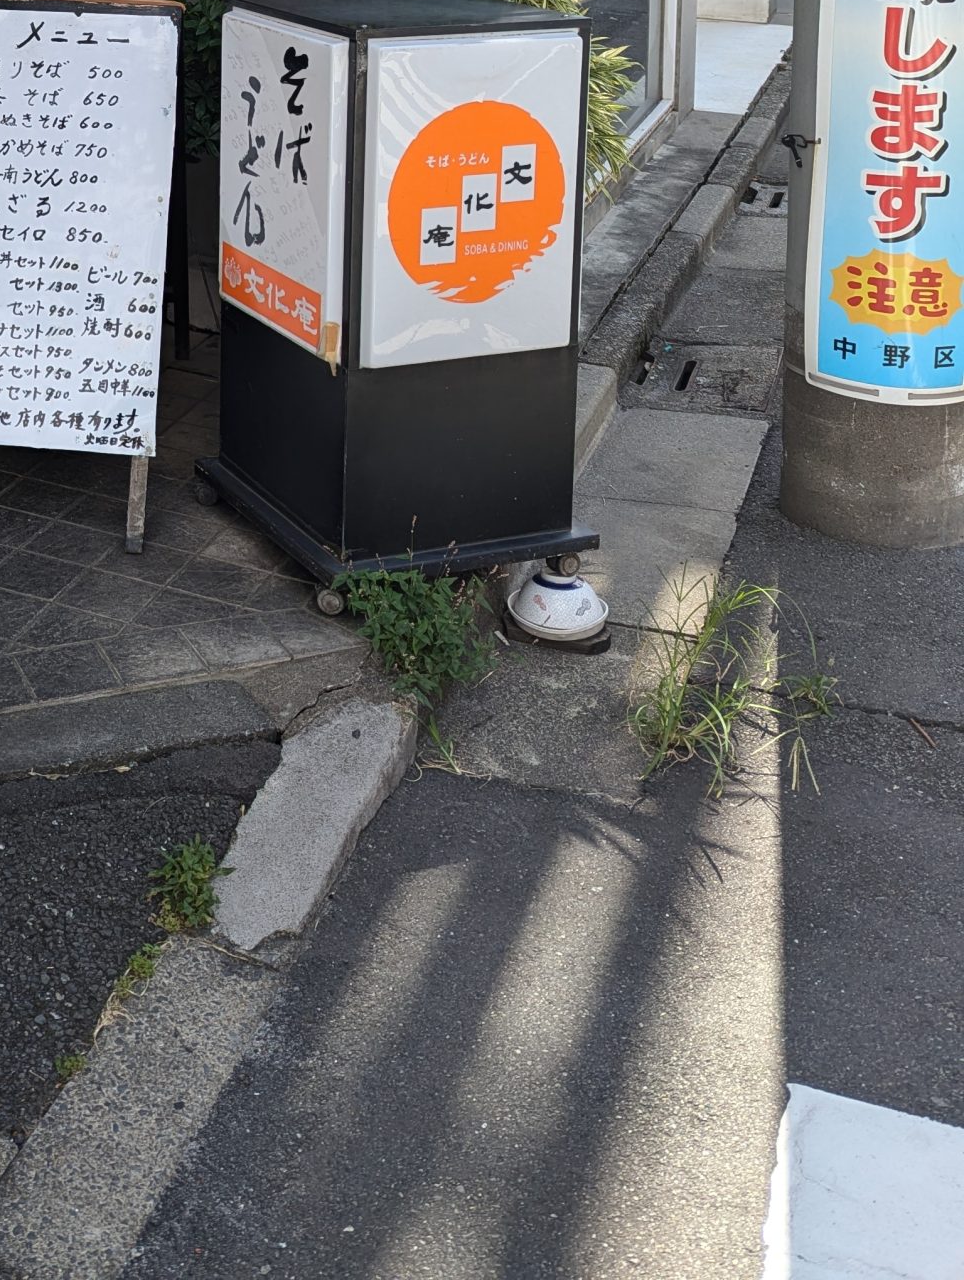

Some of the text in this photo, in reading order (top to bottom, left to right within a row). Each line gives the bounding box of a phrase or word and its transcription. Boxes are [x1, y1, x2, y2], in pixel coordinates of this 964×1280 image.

[15, 21, 130, 49] メニュー
[88, 66, 123, 79] 500
[83, 91, 119, 107] 650
[79, 116, 113, 130] 600
[274, 46, 312, 186] そば
[74, 144, 108, 159] 750
[233, 76, 266, 247] うどん
[425, 153, 490, 168] そば・うどん
[69, 171, 98, 185] 800
[464, 240, 529, 256] SOBA & DINING
[87, 266, 158, 286] ビール 700
[846, 261, 948, 318] 注意
[85, 293, 156, 314] 酒 600
[243, 267, 318, 336] 文化庵
[81, 316, 152, 340] 焼酎 600
[833, 337, 956, 369] 中野区
[78, 358, 152, 376] タンメン 800
